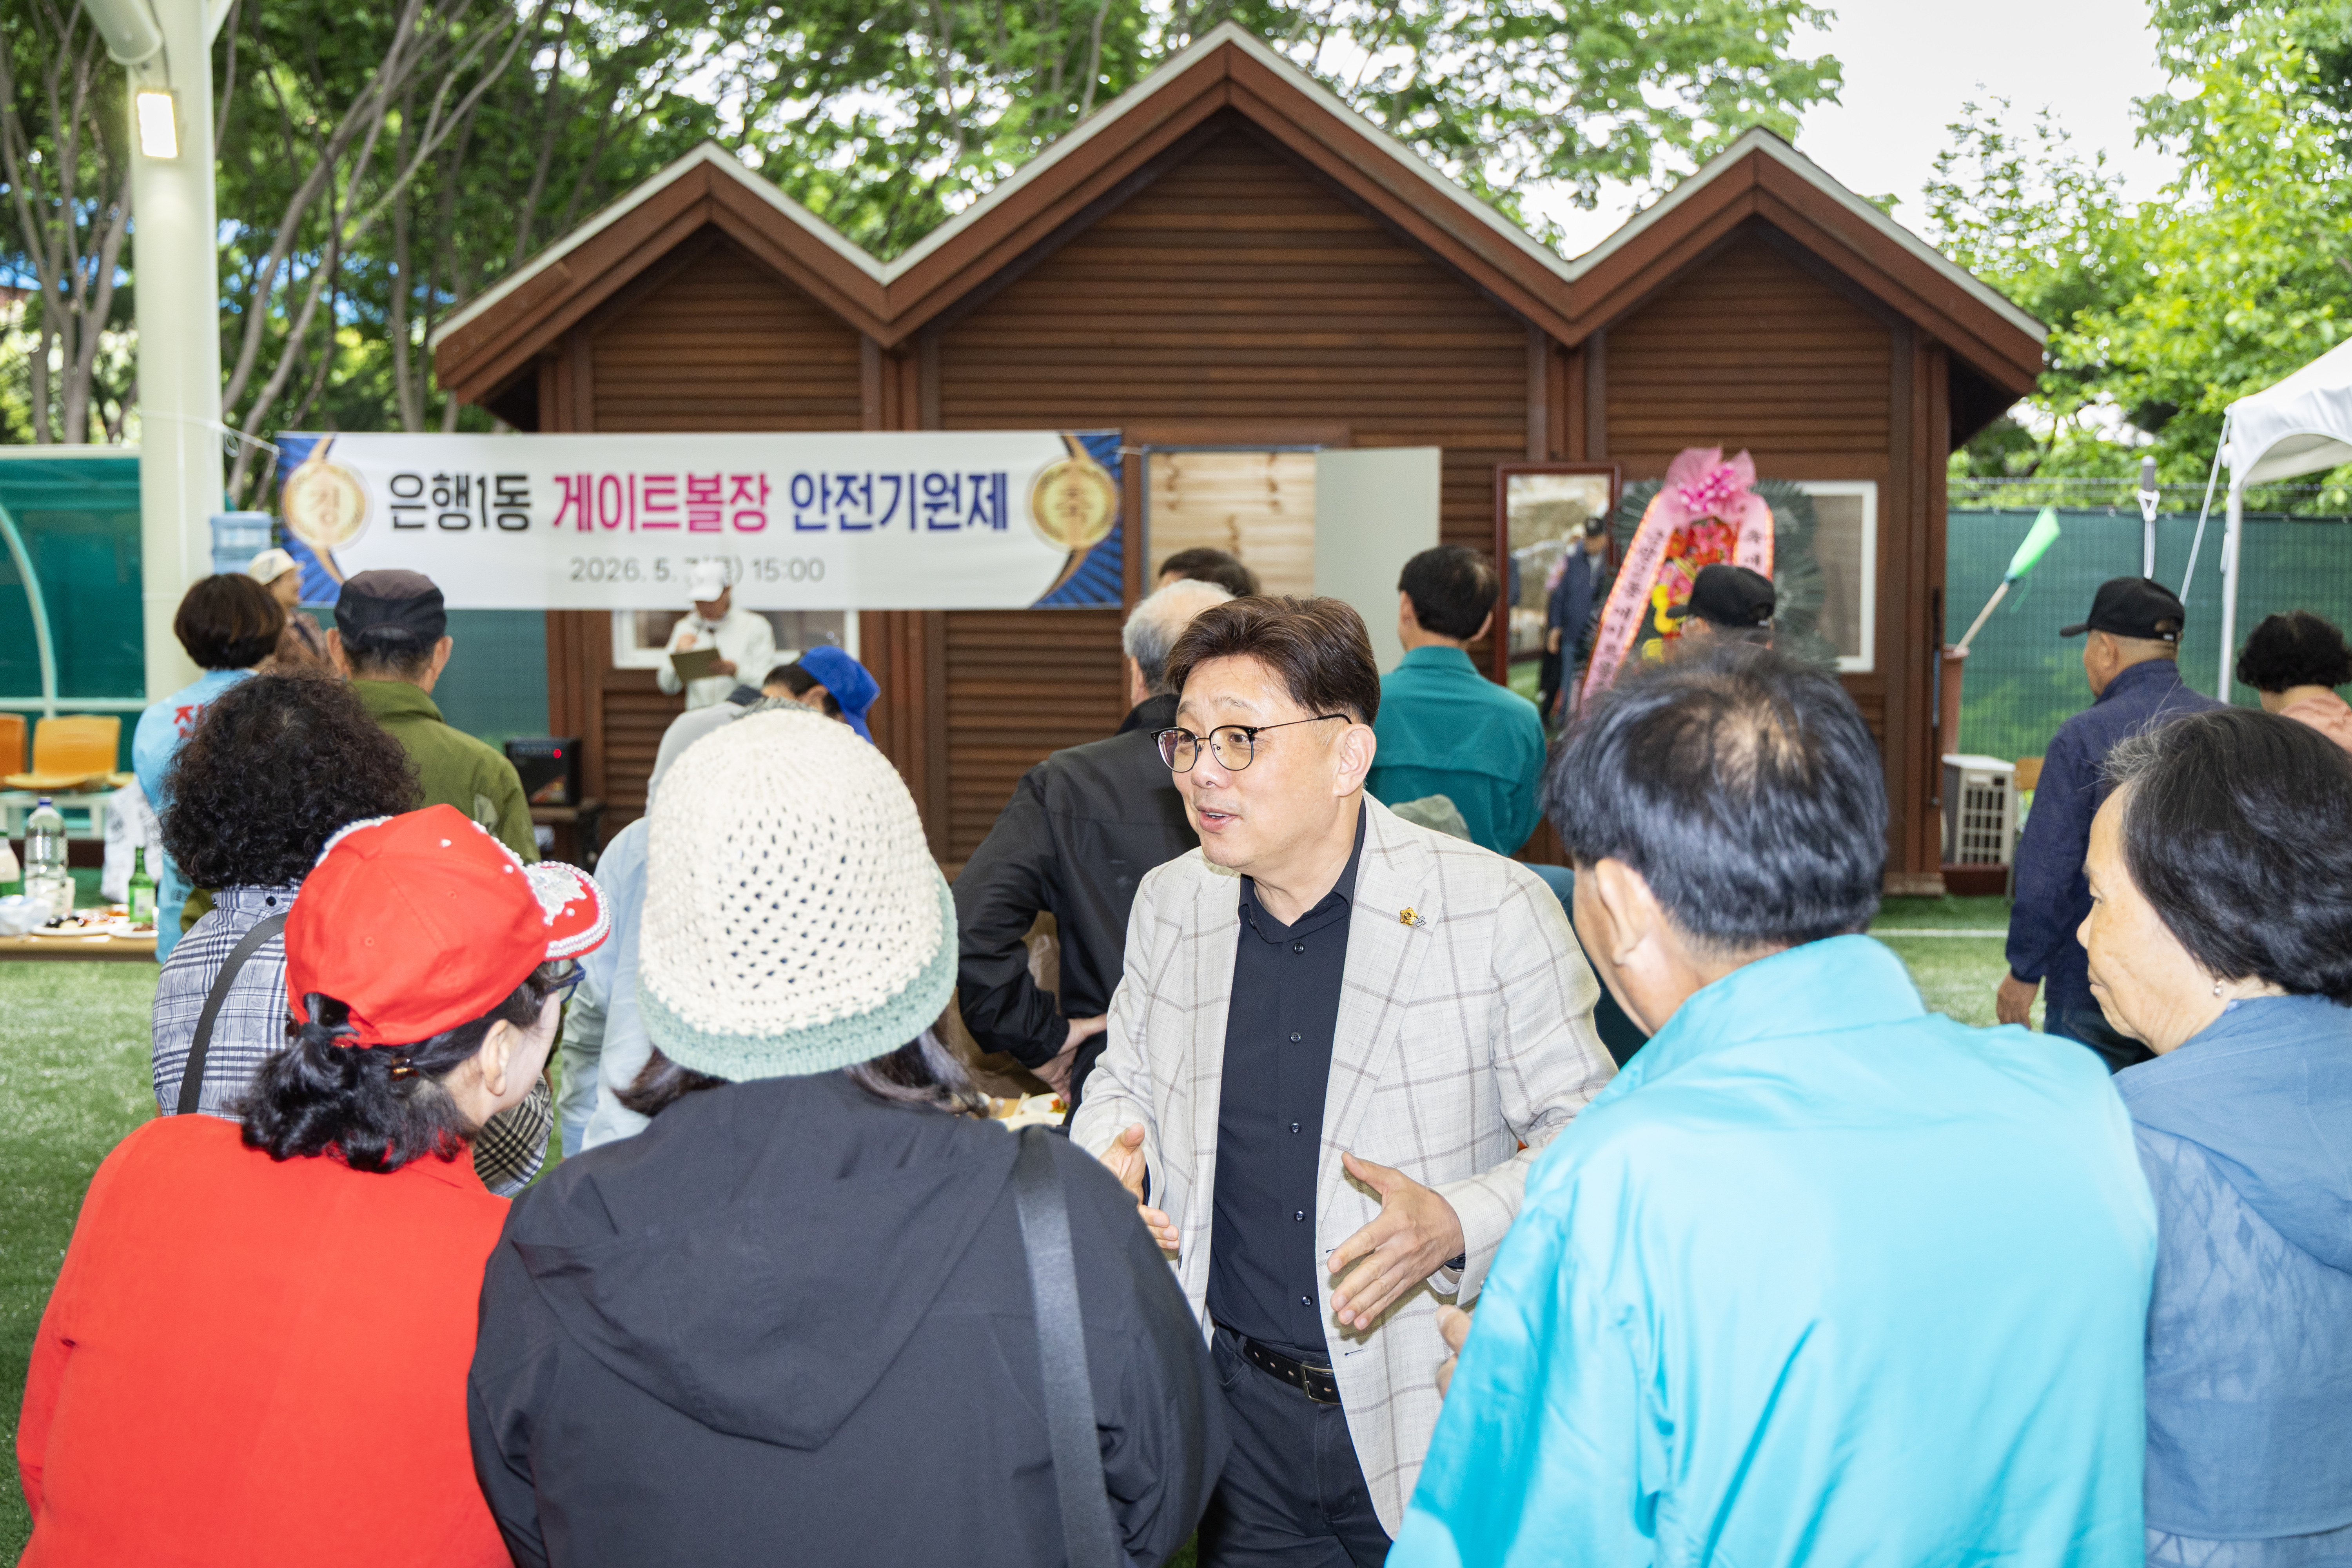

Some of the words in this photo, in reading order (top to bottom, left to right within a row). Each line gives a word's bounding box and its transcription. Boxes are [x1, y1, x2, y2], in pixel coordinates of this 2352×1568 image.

[389, 472, 532, 532] 은행1동
[553, 472, 771, 532] 게이트볼장
[790, 472, 1008, 532] 안전기원제
[570, 557, 647, 582] 2026.
[655, 557, 676, 582] 5.
[751, 557, 825, 583] 15:00
